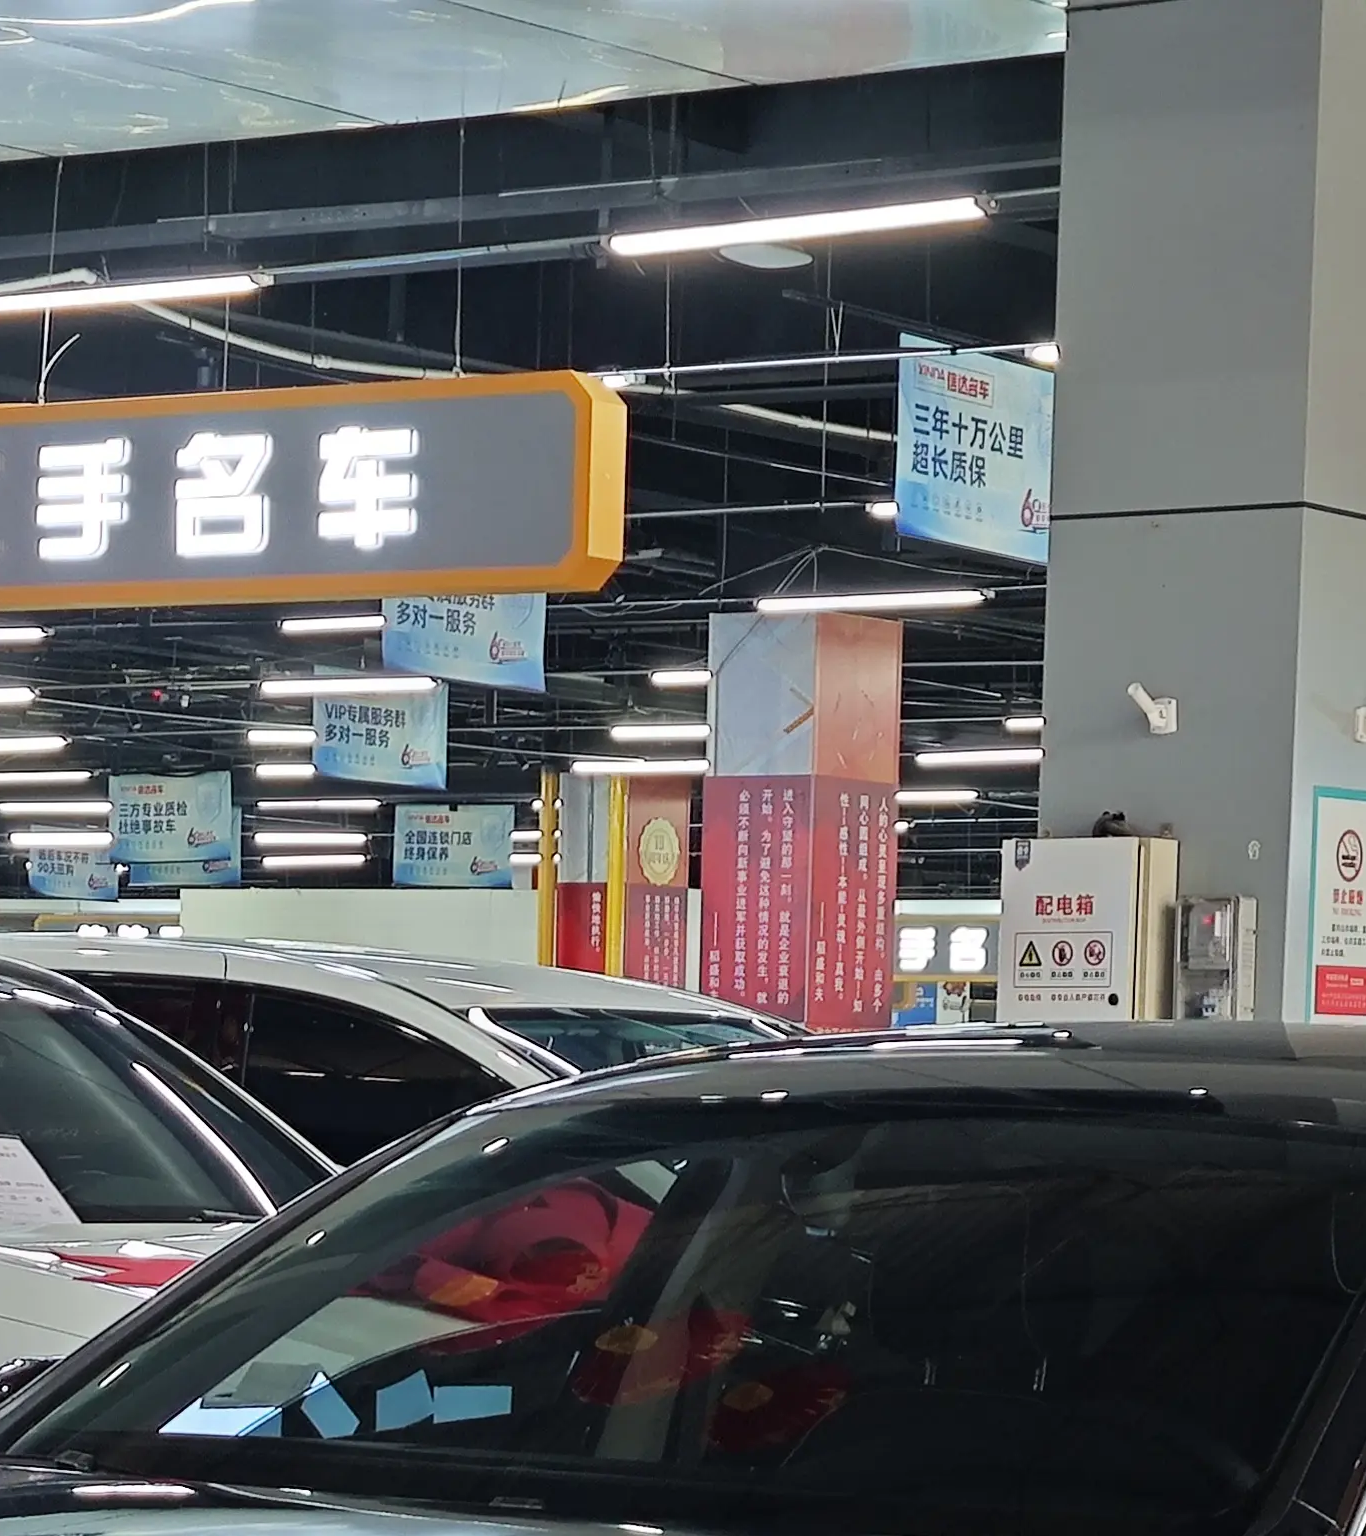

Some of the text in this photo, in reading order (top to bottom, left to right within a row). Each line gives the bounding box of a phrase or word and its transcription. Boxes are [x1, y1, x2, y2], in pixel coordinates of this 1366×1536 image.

[947, 370, 990, 400] 信达名车
[913, 403, 1025, 459] 三年十万公里
[911, 440, 987, 488] 超长质保
[396, 601, 477, 636] 多对一服务
[324, 703, 407, 728] VIP专属服务群
[324, 723, 391, 748] 多对一服务
[405, 830, 473, 846] 全国连锁门店
[1035, 894, 1094, 916] 配电箱
